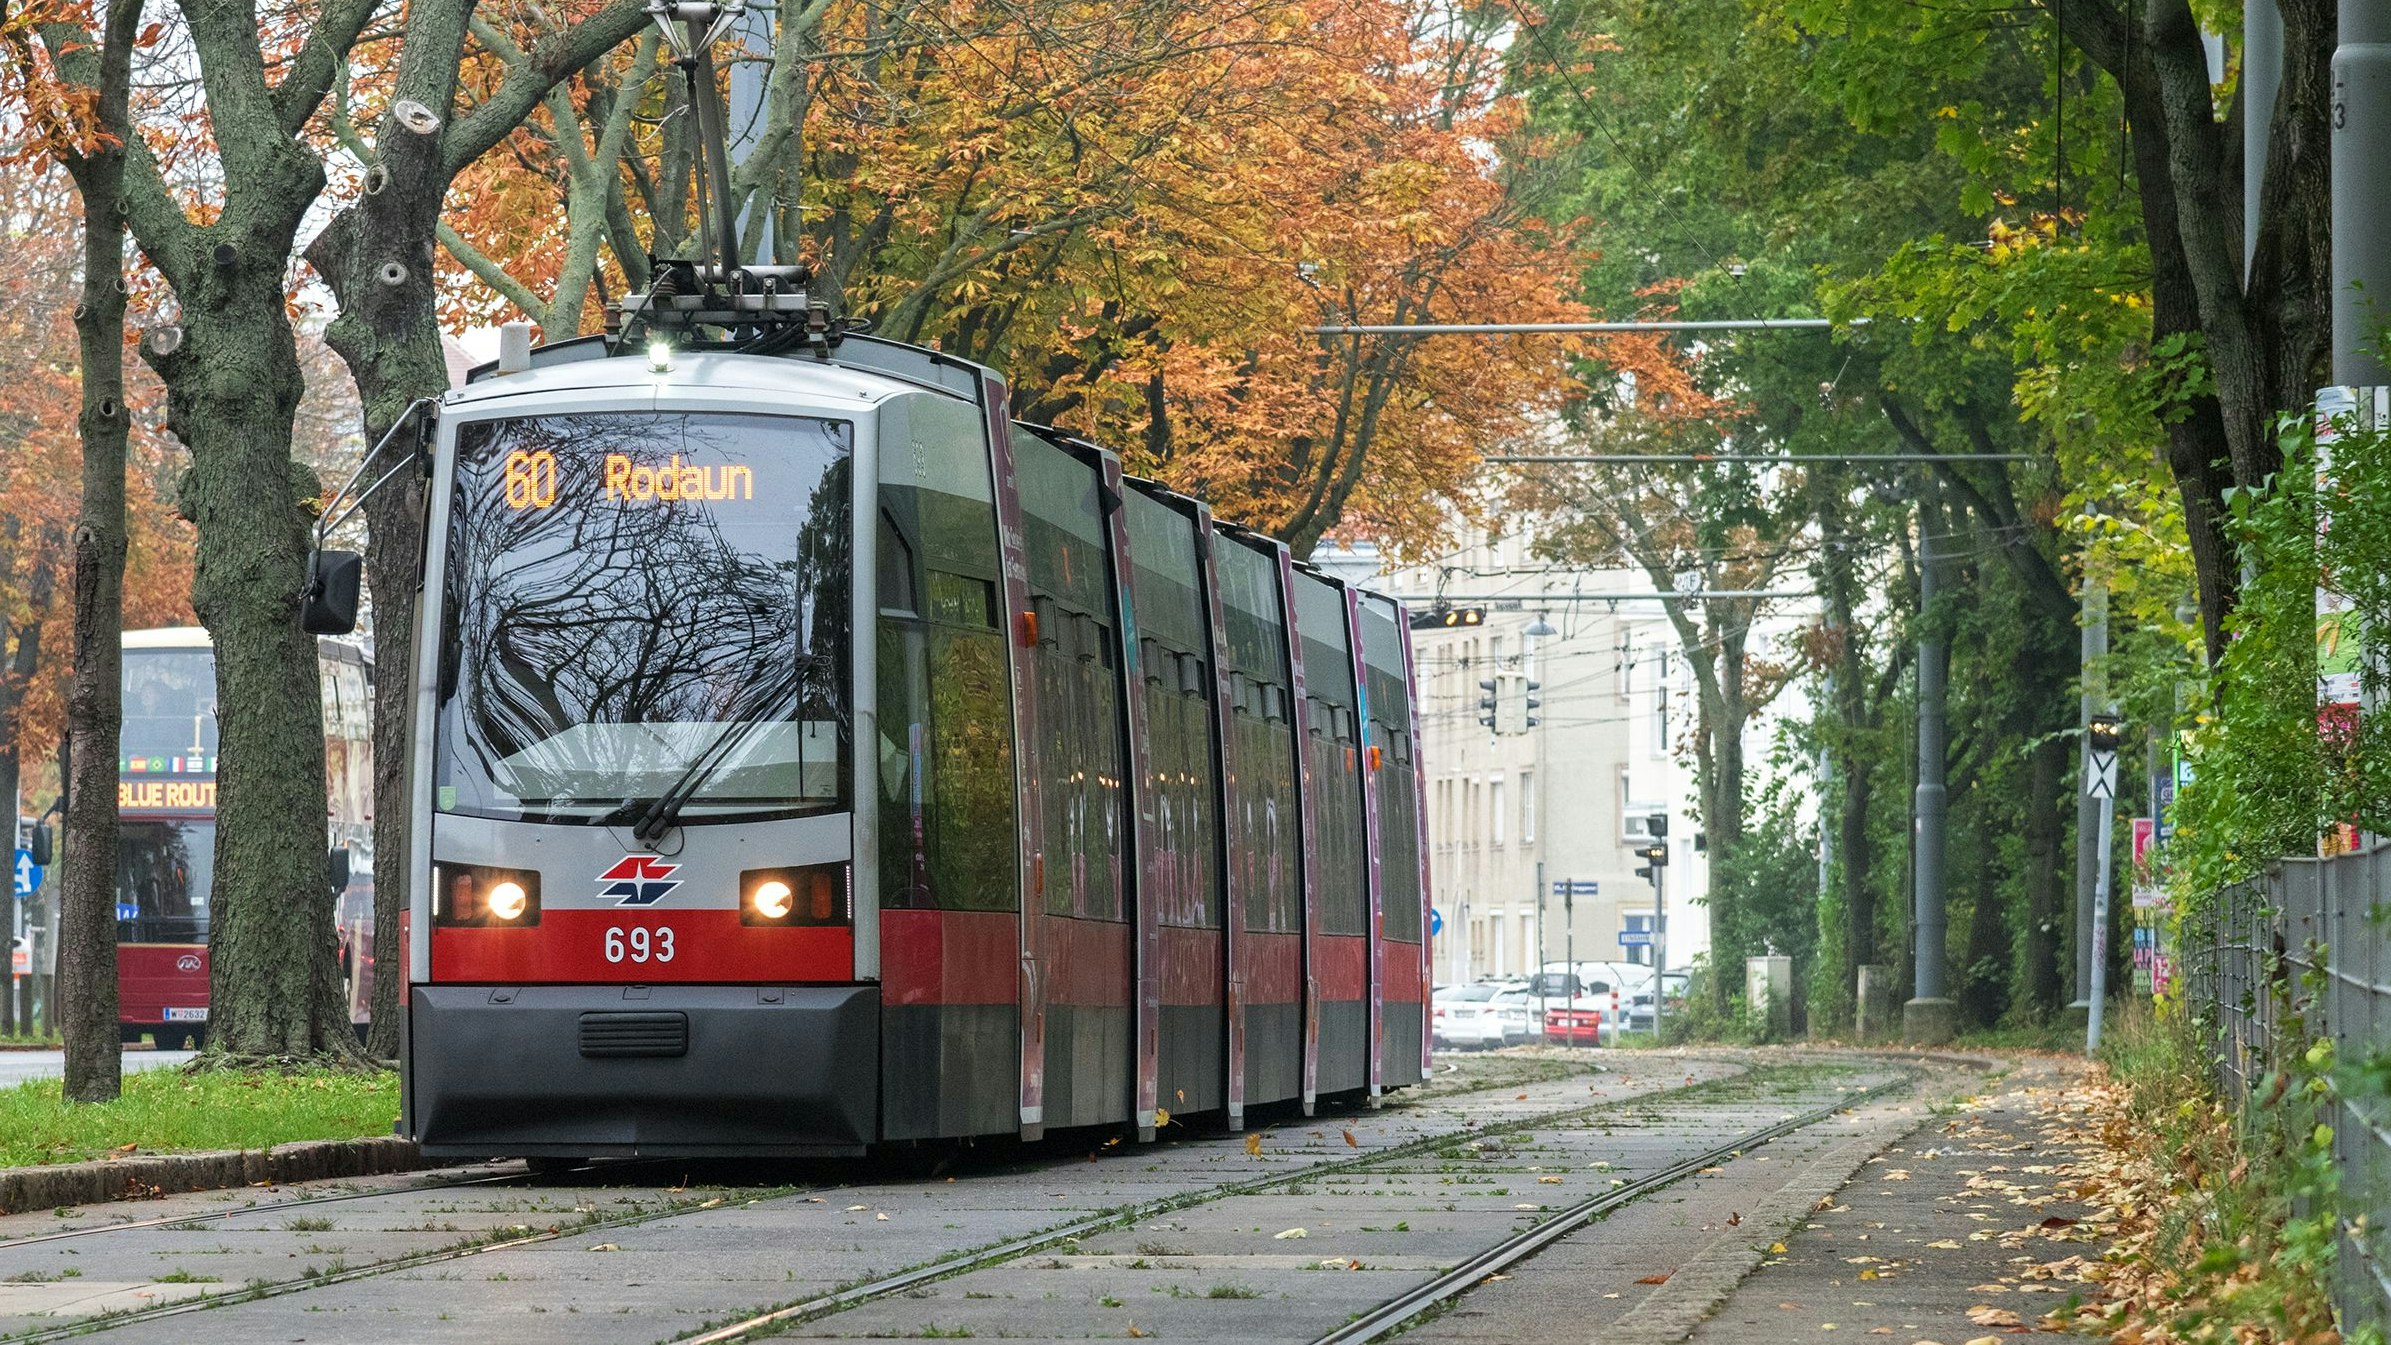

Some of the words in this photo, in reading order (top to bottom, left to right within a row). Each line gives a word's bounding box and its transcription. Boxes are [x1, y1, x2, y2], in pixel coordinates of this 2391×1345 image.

[506, 450, 556, 508] 60
[605, 453, 753, 500] Rodaun
[118, 782, 163, 807] BLUE
[166, 782, 217, 807] ROUT
[604, 926, 676, 964] 693
